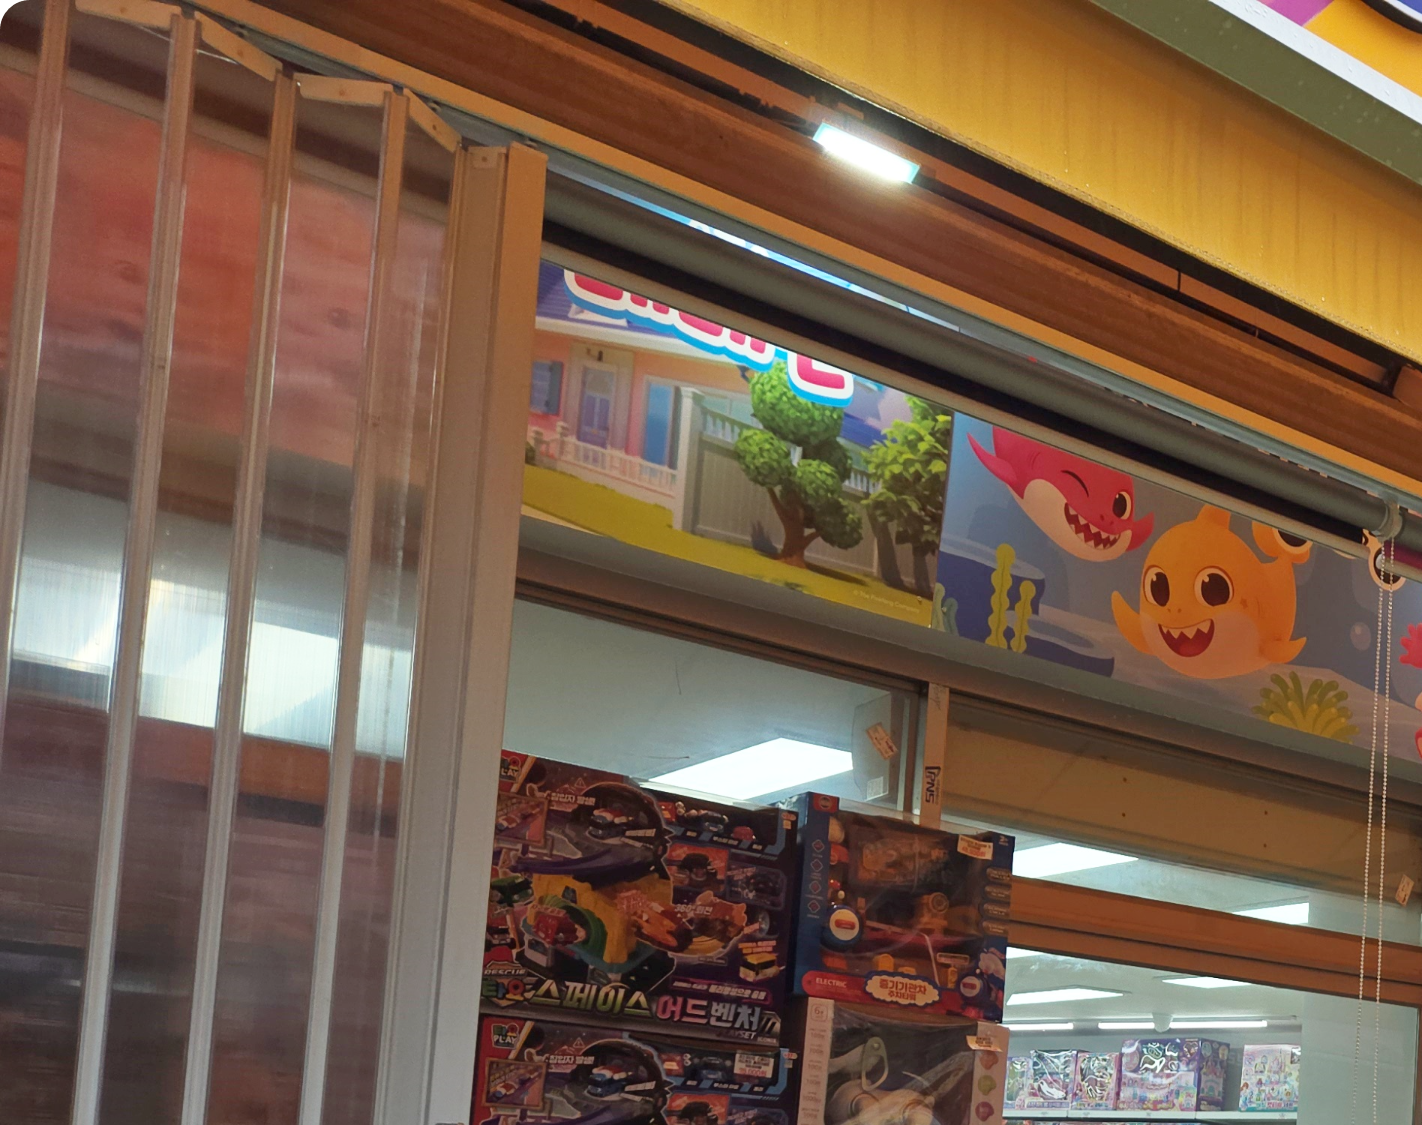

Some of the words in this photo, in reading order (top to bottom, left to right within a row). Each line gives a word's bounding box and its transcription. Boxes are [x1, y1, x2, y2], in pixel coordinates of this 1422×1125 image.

[815, 977, 847, 988] ELECTRIC
[879, 977, 927, 995] 증기기관차
[531, 979, 653, 1014] 스페이스
[656, 995, 760, 1030] 어드벤처
